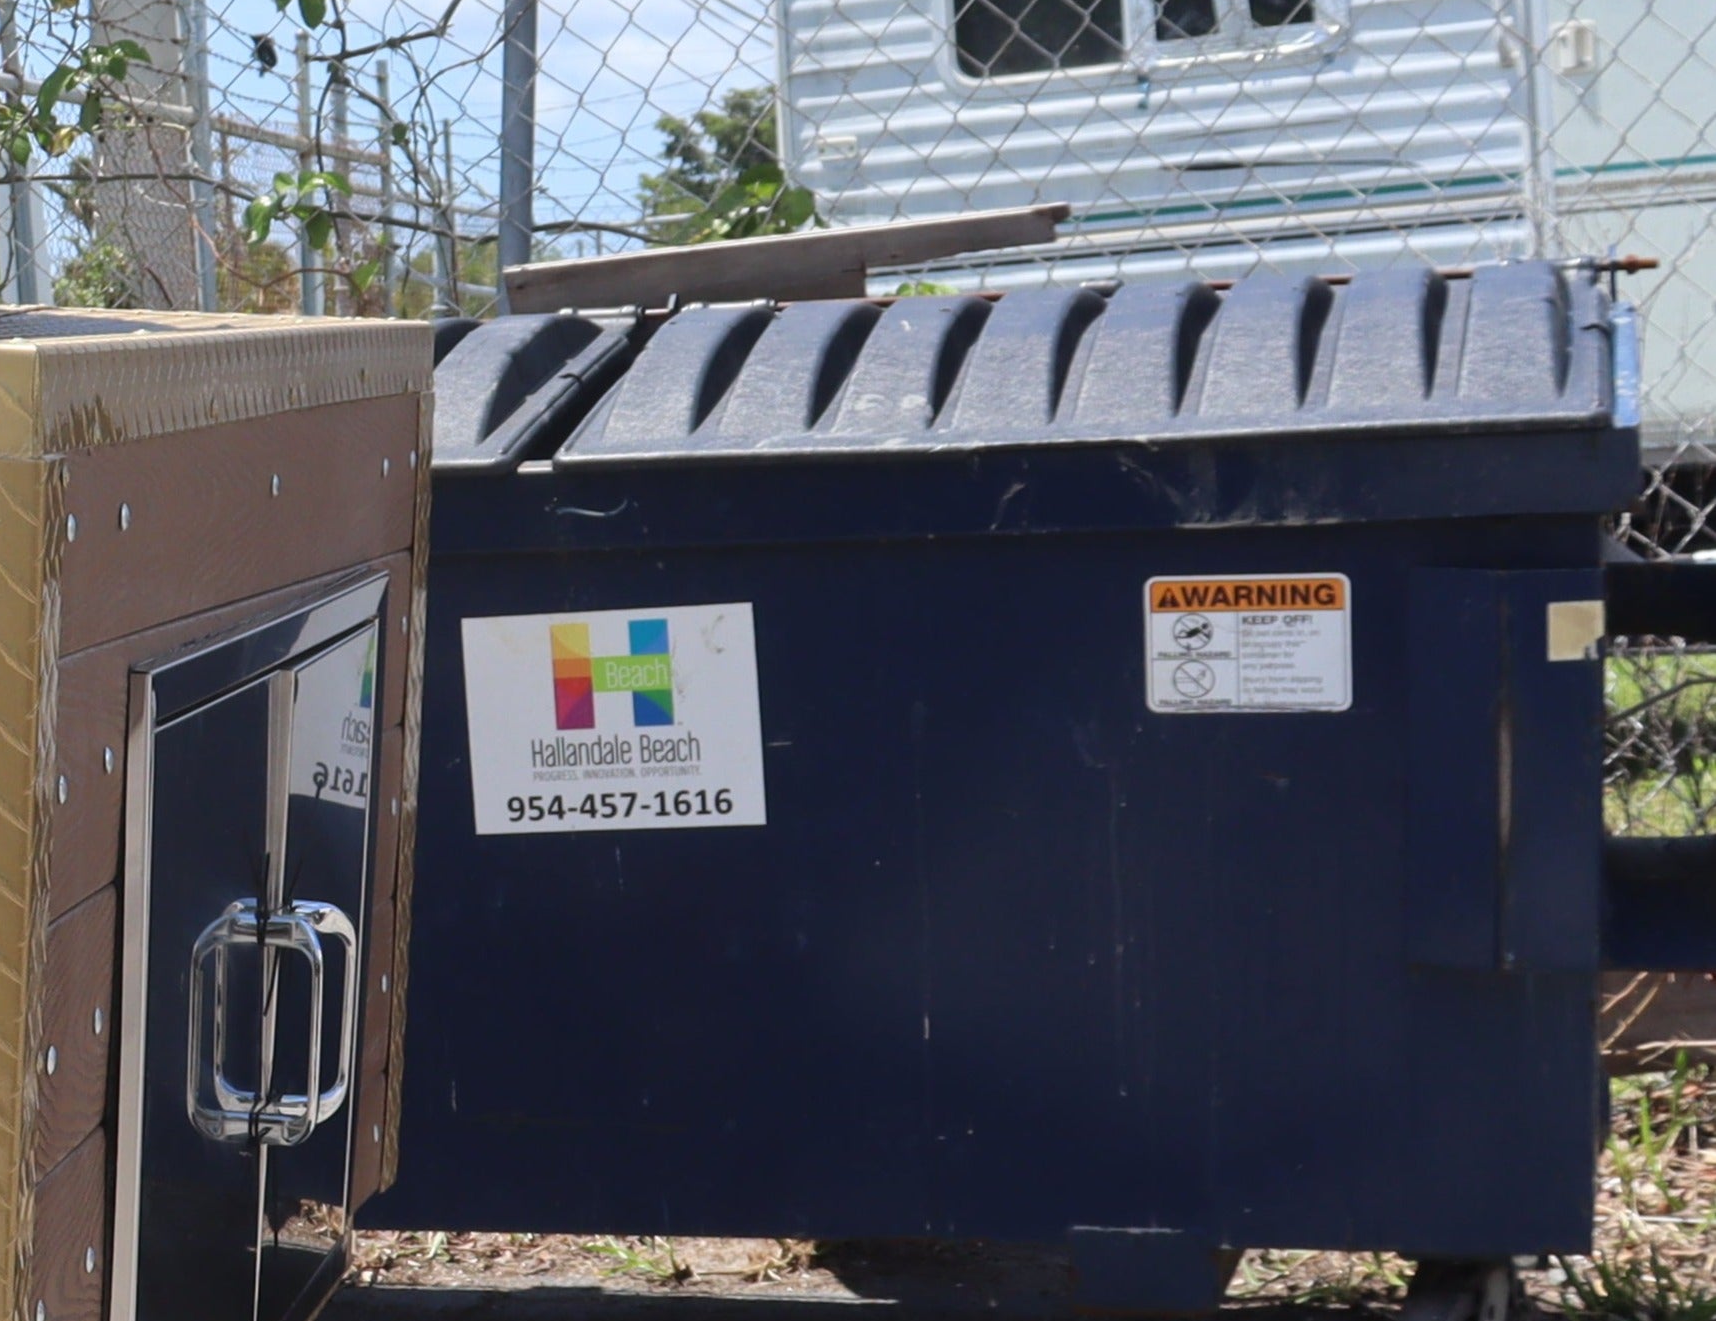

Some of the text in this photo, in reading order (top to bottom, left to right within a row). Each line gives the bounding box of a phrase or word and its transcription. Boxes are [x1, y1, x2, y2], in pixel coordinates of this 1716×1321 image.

[1180, 584, 1336, 607] WARNING
[1241, 615, 1278, 625] KEEP
[605, 659, 669, 689] Beach
[531, 730, 701, 768] Hallandale Beach
[507, 789, 734, 822] 954-457-1616
